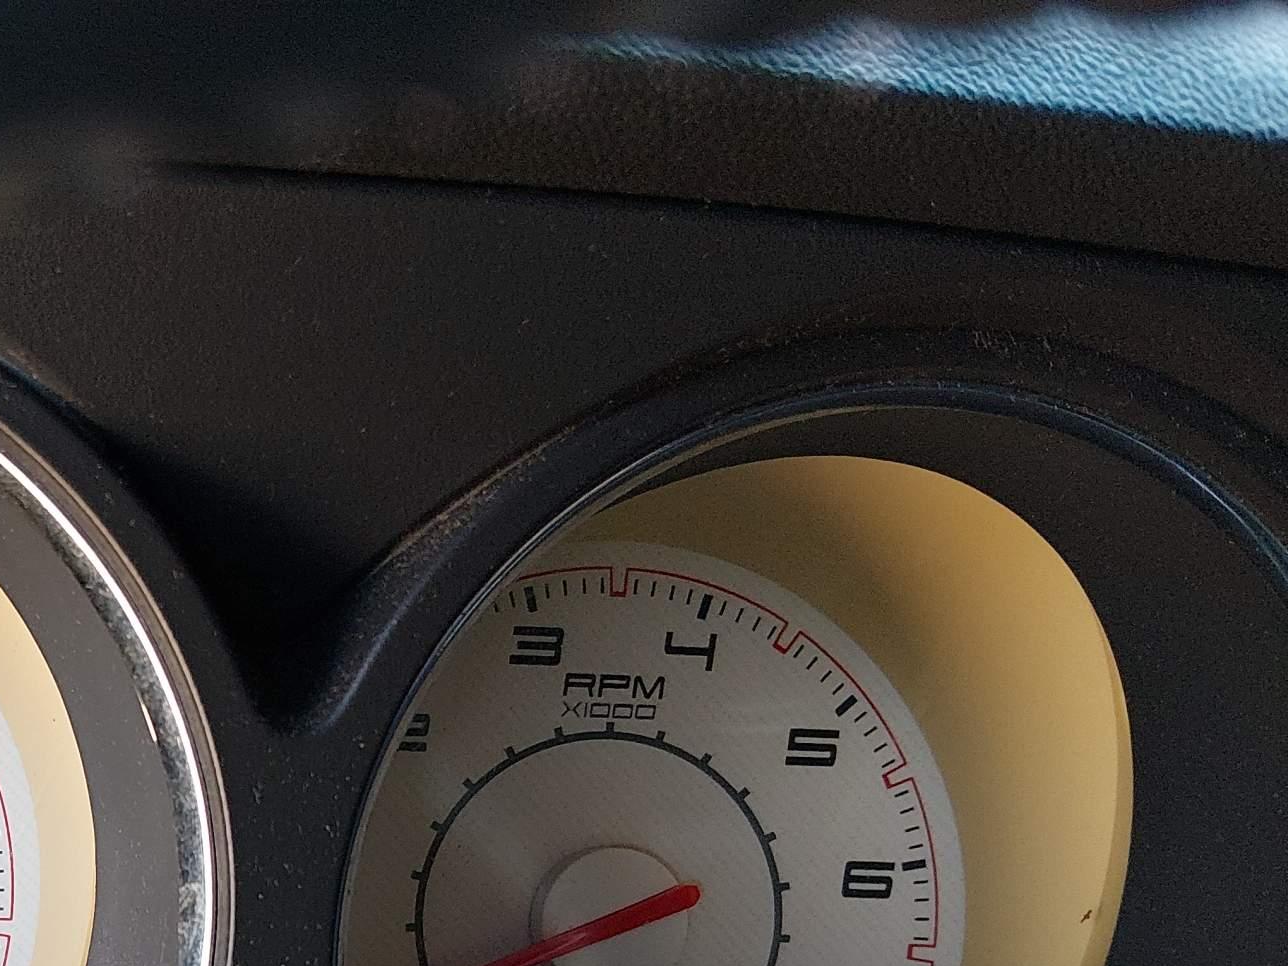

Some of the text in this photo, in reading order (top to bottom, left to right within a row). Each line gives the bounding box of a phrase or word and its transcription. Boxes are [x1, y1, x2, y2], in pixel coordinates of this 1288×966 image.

[509, 626, 564, 666] 3
[664, 631, 717, 671] 4
[562, 673, 665, 700] RPM
[561, 702, 656, 720] X1000
[785, 728, 840, 767] 5
[841, 861, 895, 898] 6
